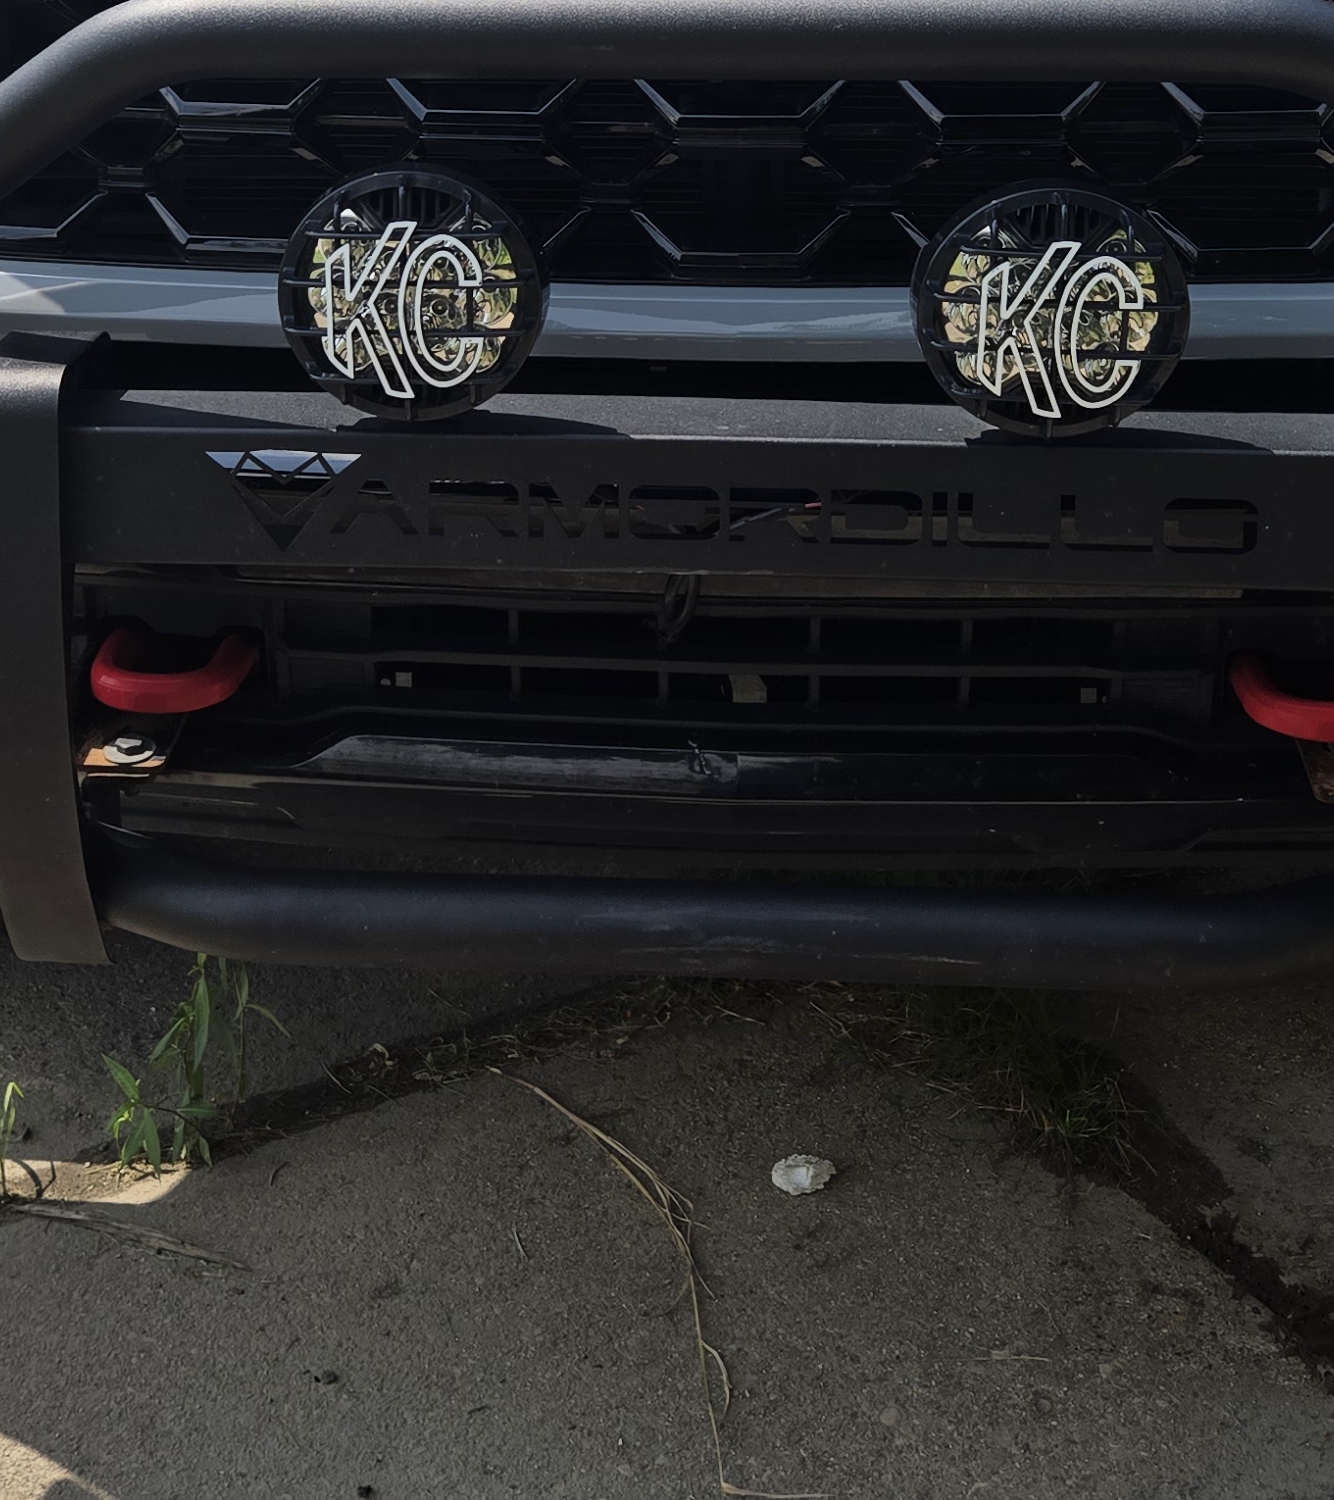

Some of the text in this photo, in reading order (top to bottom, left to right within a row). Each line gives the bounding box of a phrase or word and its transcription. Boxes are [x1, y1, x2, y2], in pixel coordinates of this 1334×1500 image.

[321, 220, 484, 399] KC
[976, 240, 1144, 419] KC
[329, 479, 1259, 555] ARMORDILLO
